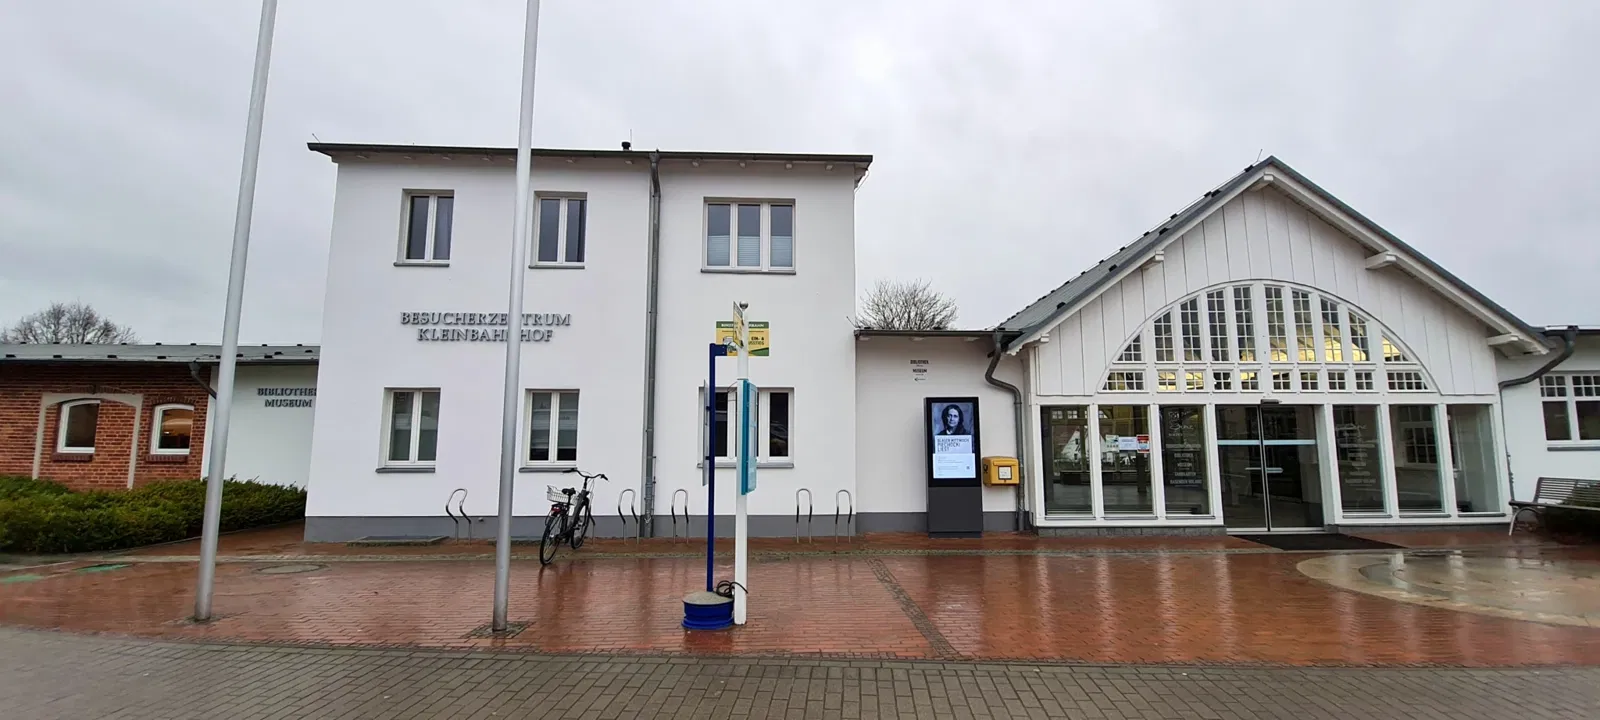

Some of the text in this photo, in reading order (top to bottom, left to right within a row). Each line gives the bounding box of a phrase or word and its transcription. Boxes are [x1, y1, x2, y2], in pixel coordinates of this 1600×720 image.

[400, 311, 571, 326] BESUCHERZETRUM
[417, 328, 553, 342] KLEINBAHHOF
[264, 398, 312, 408] MUSEUM
